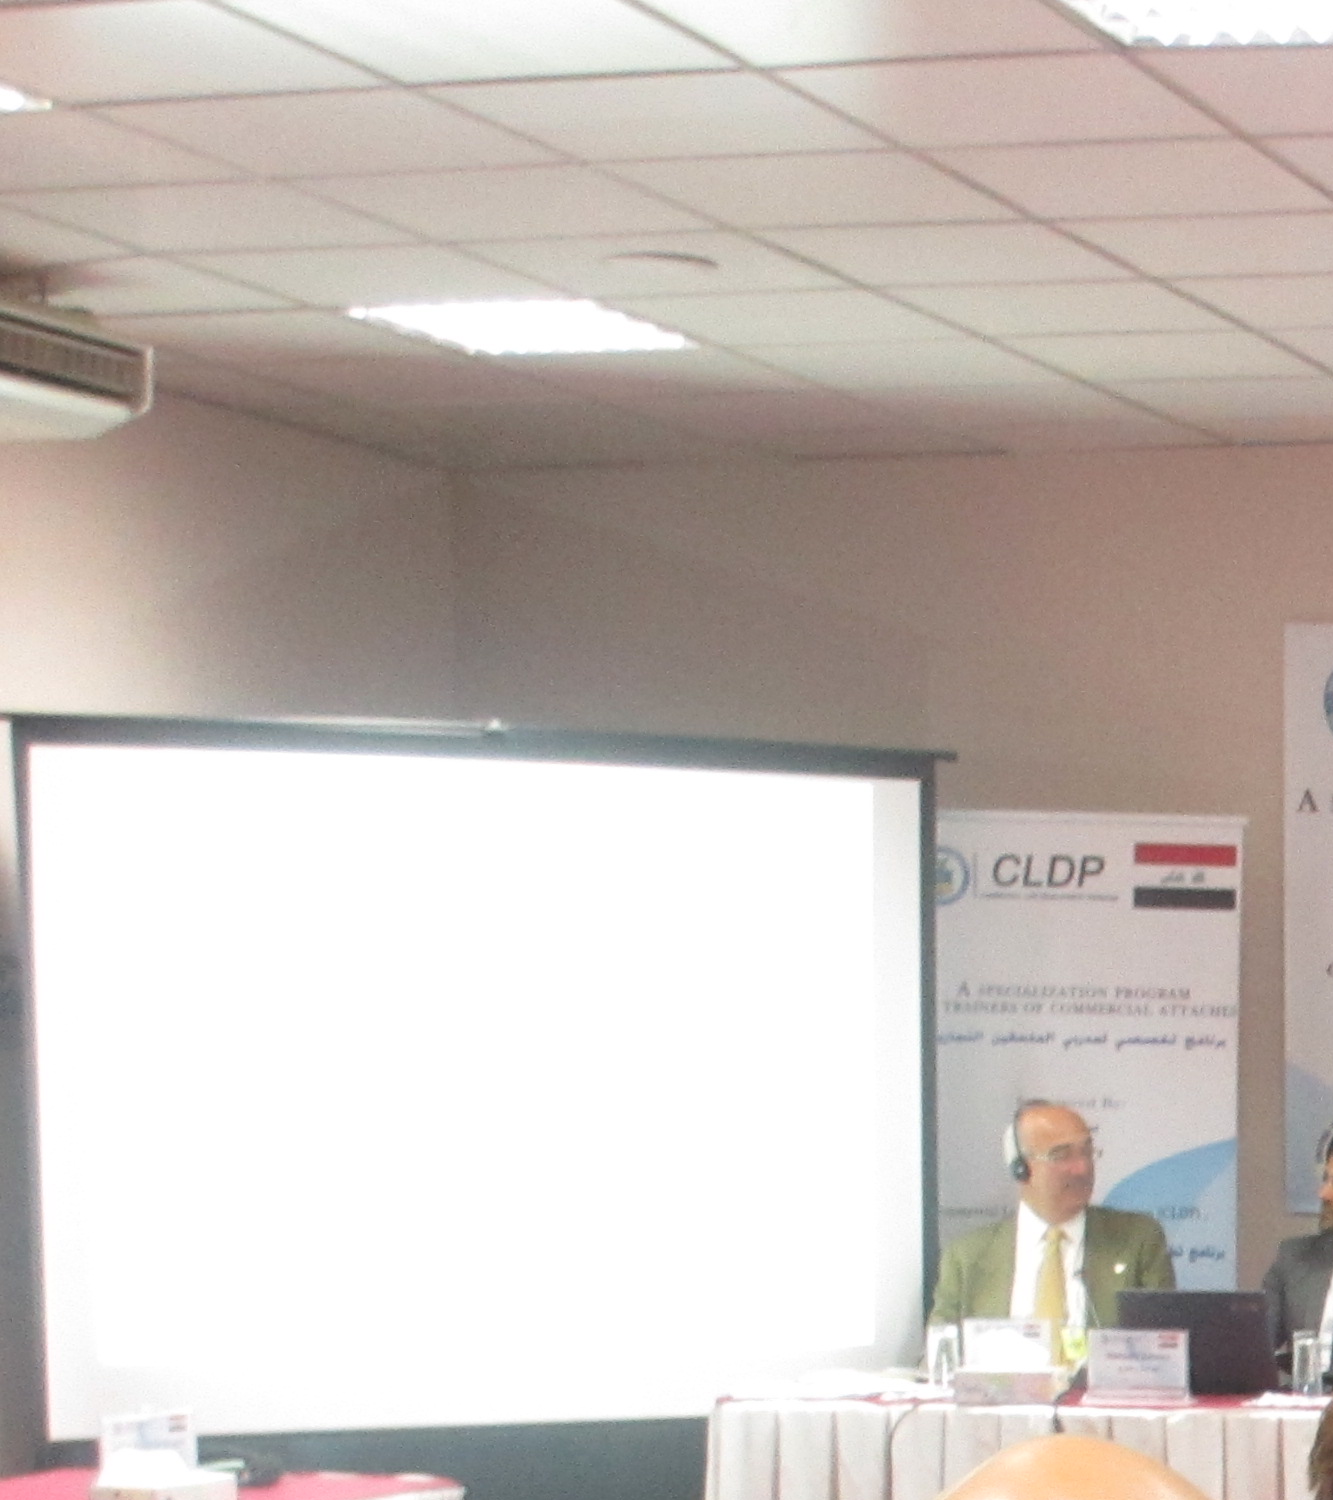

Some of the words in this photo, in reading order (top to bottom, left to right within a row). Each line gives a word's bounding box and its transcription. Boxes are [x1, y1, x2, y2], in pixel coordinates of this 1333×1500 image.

[1297, 788, 1320, 813] A
[991, 853, 1105, 888] CLDP
[1115, 985, 1191, 999] PROGRAM
